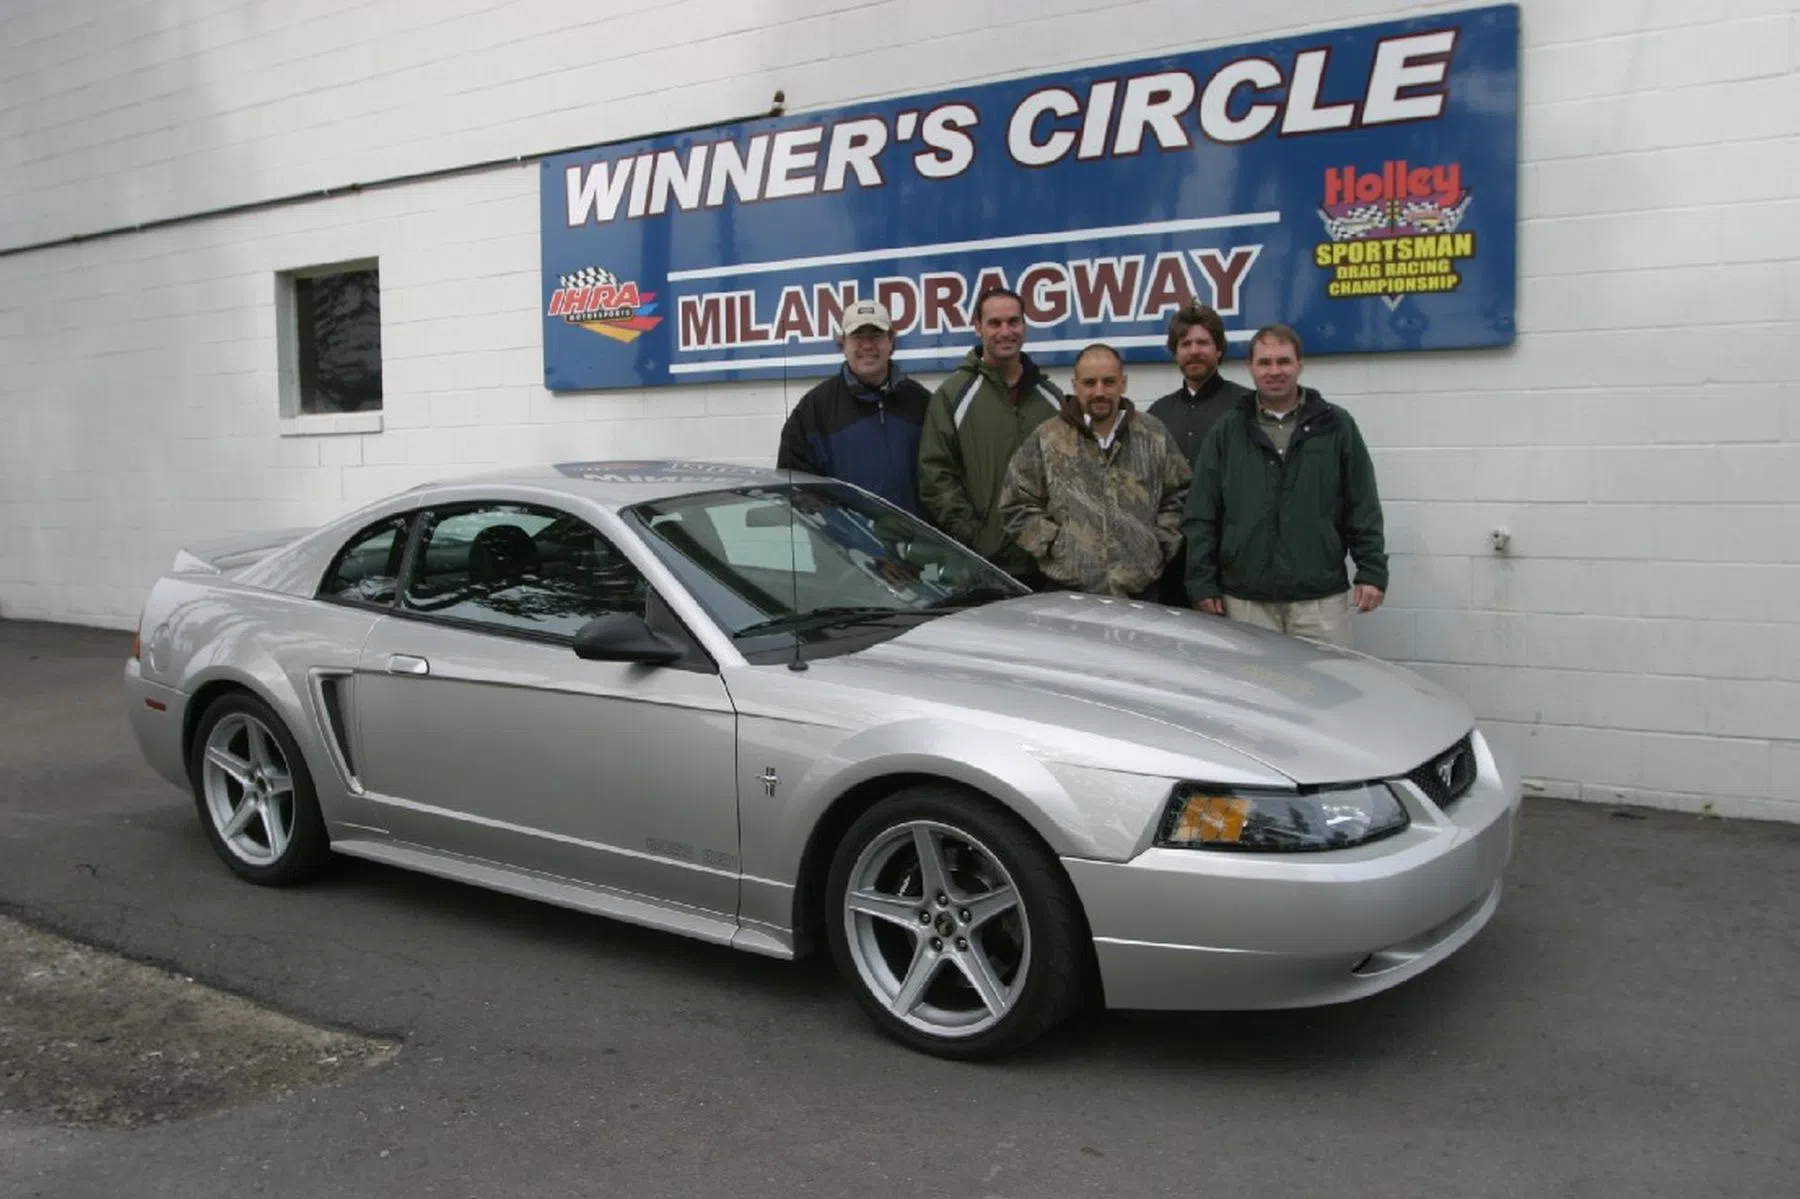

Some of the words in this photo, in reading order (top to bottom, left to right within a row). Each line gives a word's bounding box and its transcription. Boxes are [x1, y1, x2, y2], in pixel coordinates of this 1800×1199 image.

[566, 103, 978, 227] WINNER'S
[1006, 27, 1460, 168] CIRCLE
[1324, 160, 1460, 208] Holley
[1315, 233, 1472, 266] SPORTSMAN
[1328, 274, 1459, 296] CHAMPIONSHIP
[1336, 265, 1381, 280] DRAG
[1385, 258, 1450, 277] RACING
[547, 281, 640, 316] IHRA
[567, 308, 632, 321] MOTORSPORTS
[679, 280, 858, 351] MILAN
